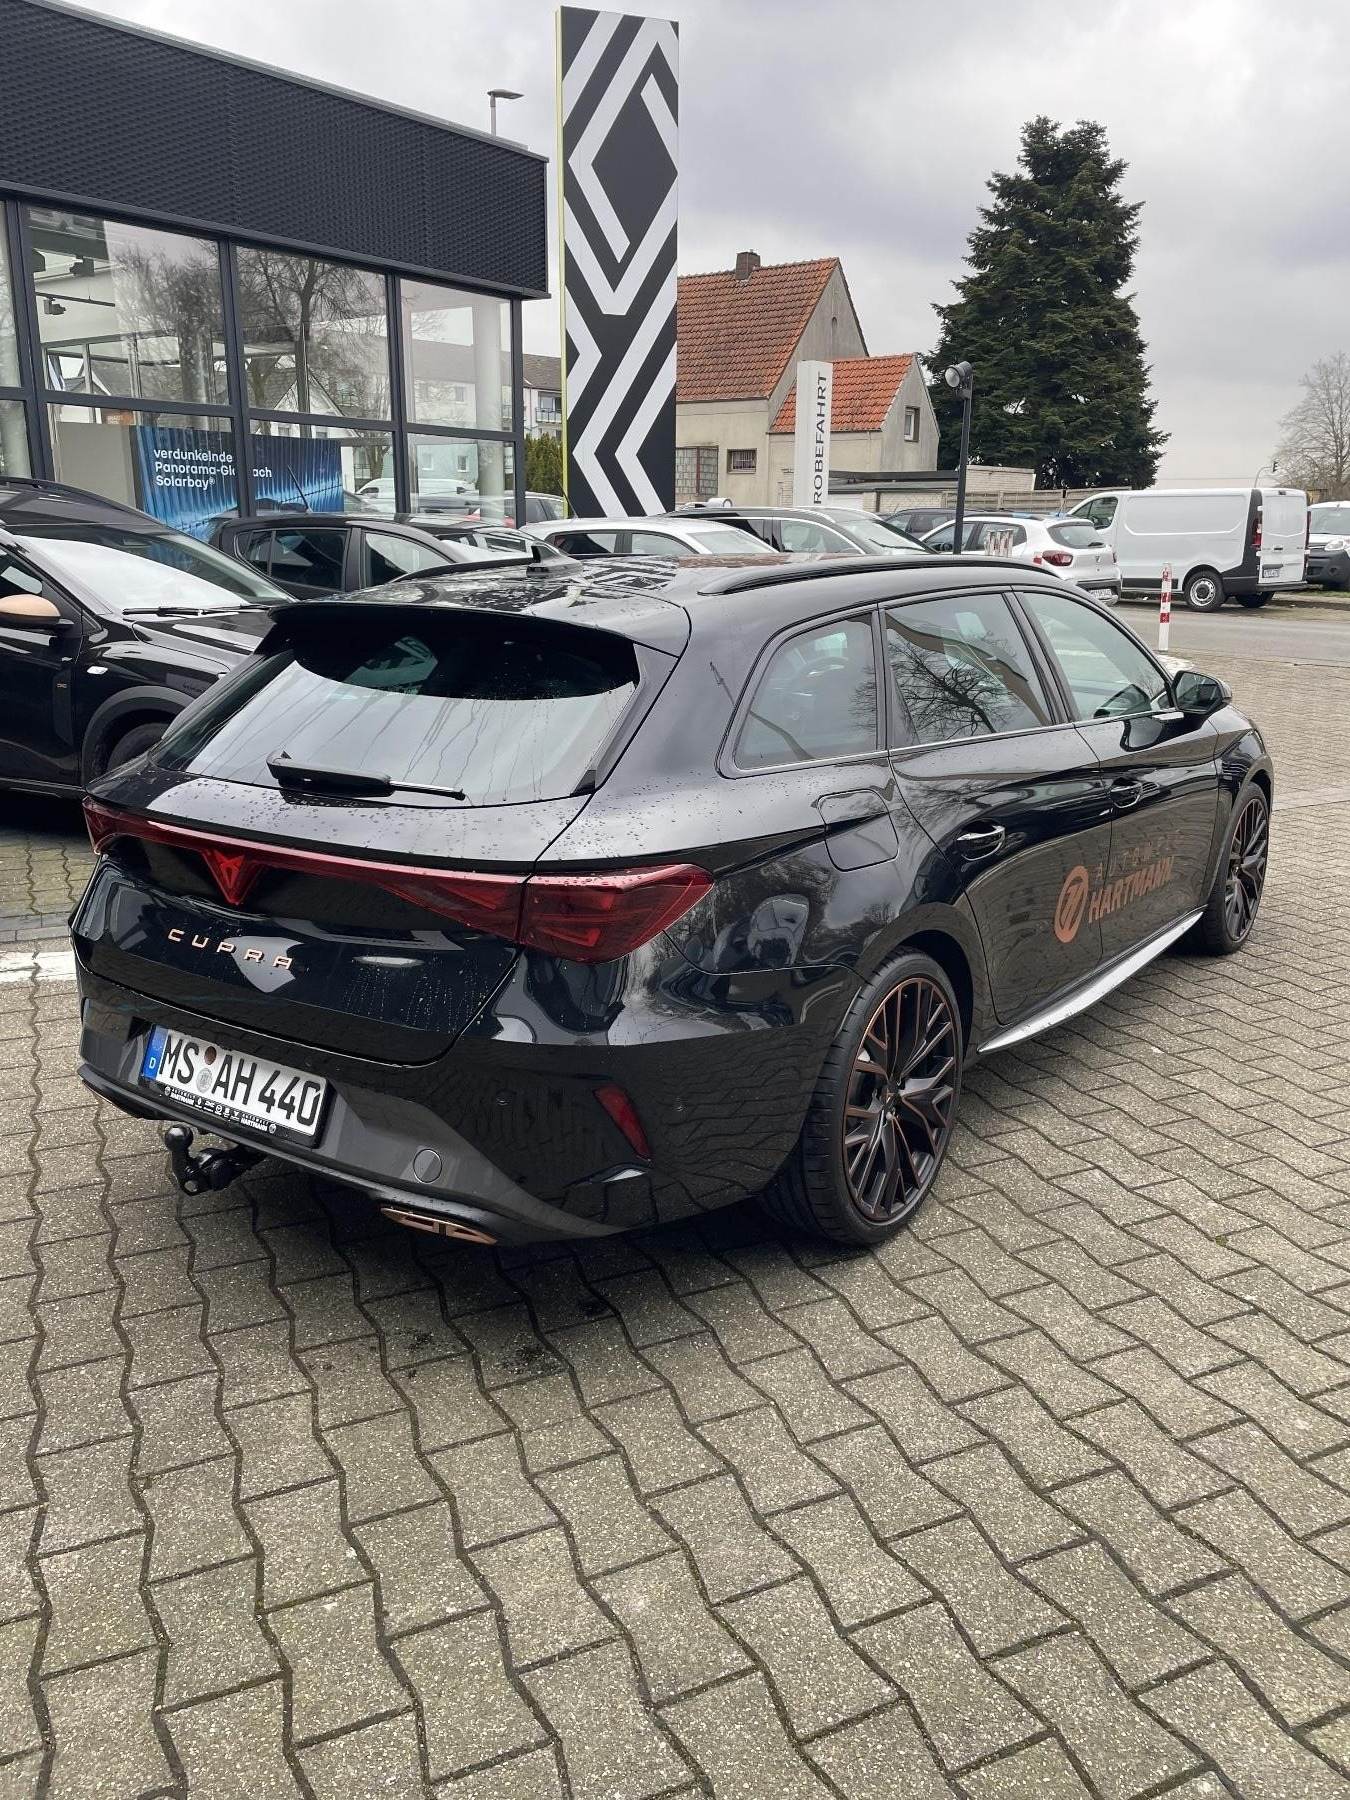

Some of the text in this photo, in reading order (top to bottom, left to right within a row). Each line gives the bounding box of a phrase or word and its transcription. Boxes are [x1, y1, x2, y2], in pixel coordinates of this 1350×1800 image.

[153, 448, 233, 463] verdunkelnde
[813, 370, 828, 505] ROBEFAHRT
[1088, 855, 1175, 924] HARTMANN
[167, 928, 293, 970] CUPRA
[148, 1034, 323, 1127] D MS AH 440
